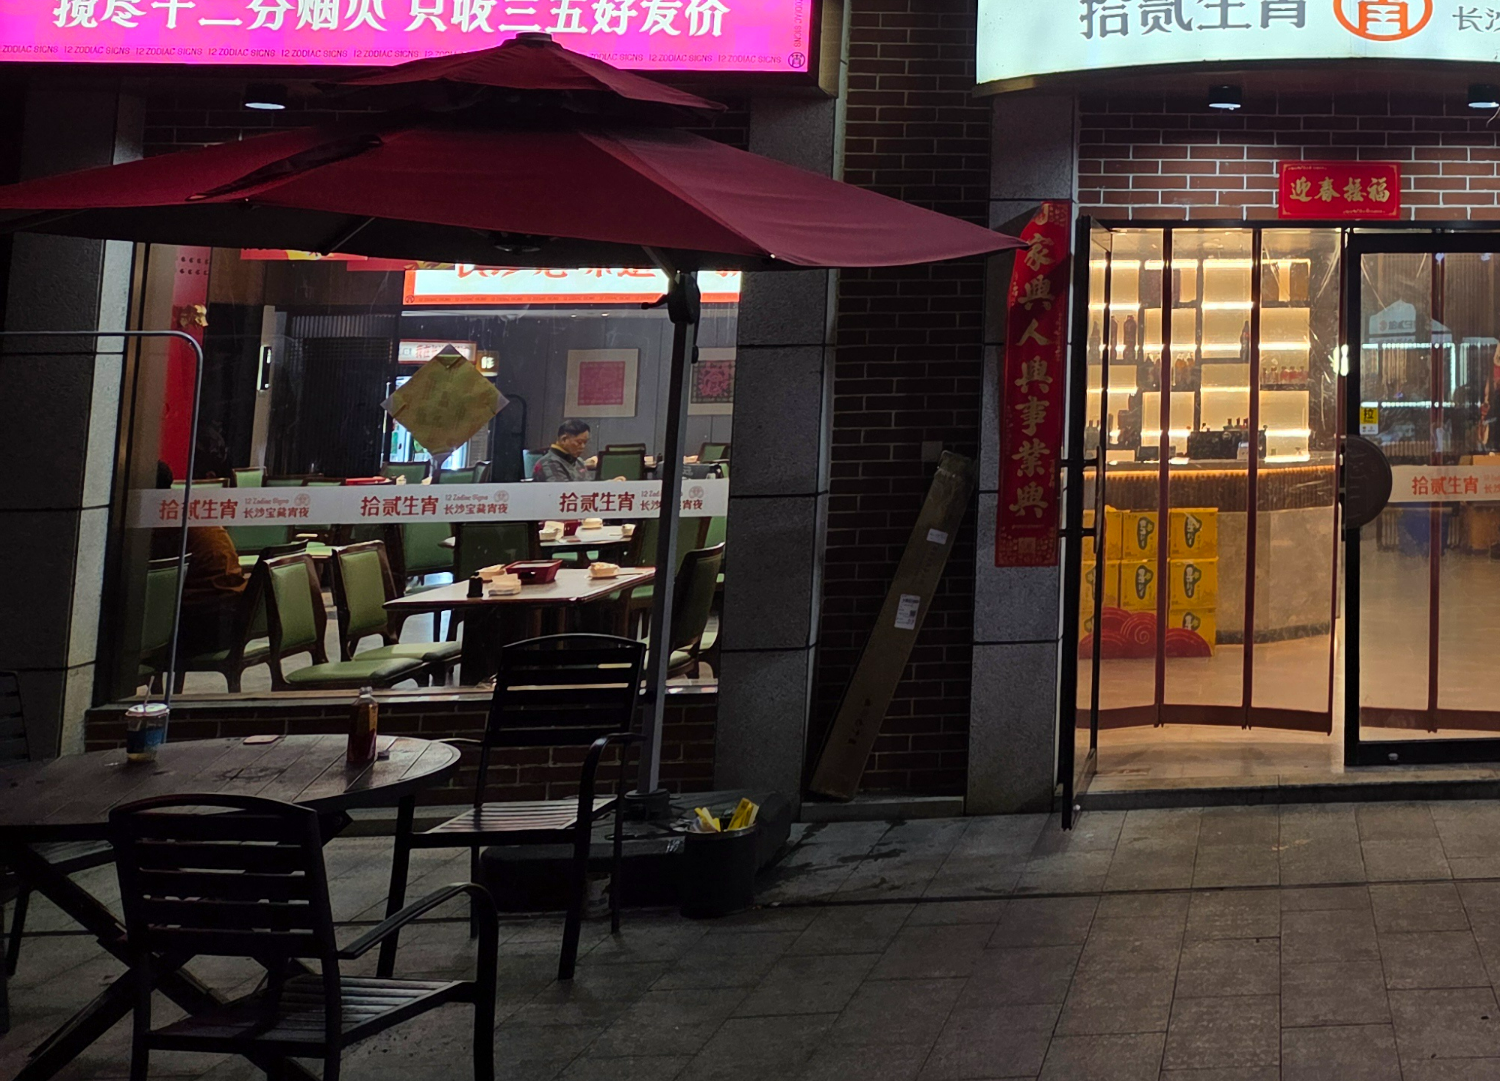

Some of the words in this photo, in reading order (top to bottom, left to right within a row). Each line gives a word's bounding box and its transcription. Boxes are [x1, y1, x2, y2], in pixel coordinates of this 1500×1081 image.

[1289, 176, 1390, 202] 迎春接福
[1411, 475, 1479, 496] 拾贰生宵
[360, 495, 439, 517] 拾贰生宵
[443, 503, 508, 515] 长沙宝藏宵夜
[559, 491, 635, 513] 拾贰生宵
[640, 499, 703, 511] 长沙宵夜
[243, 507, 310, 519] 长沙宝藏宵夜
